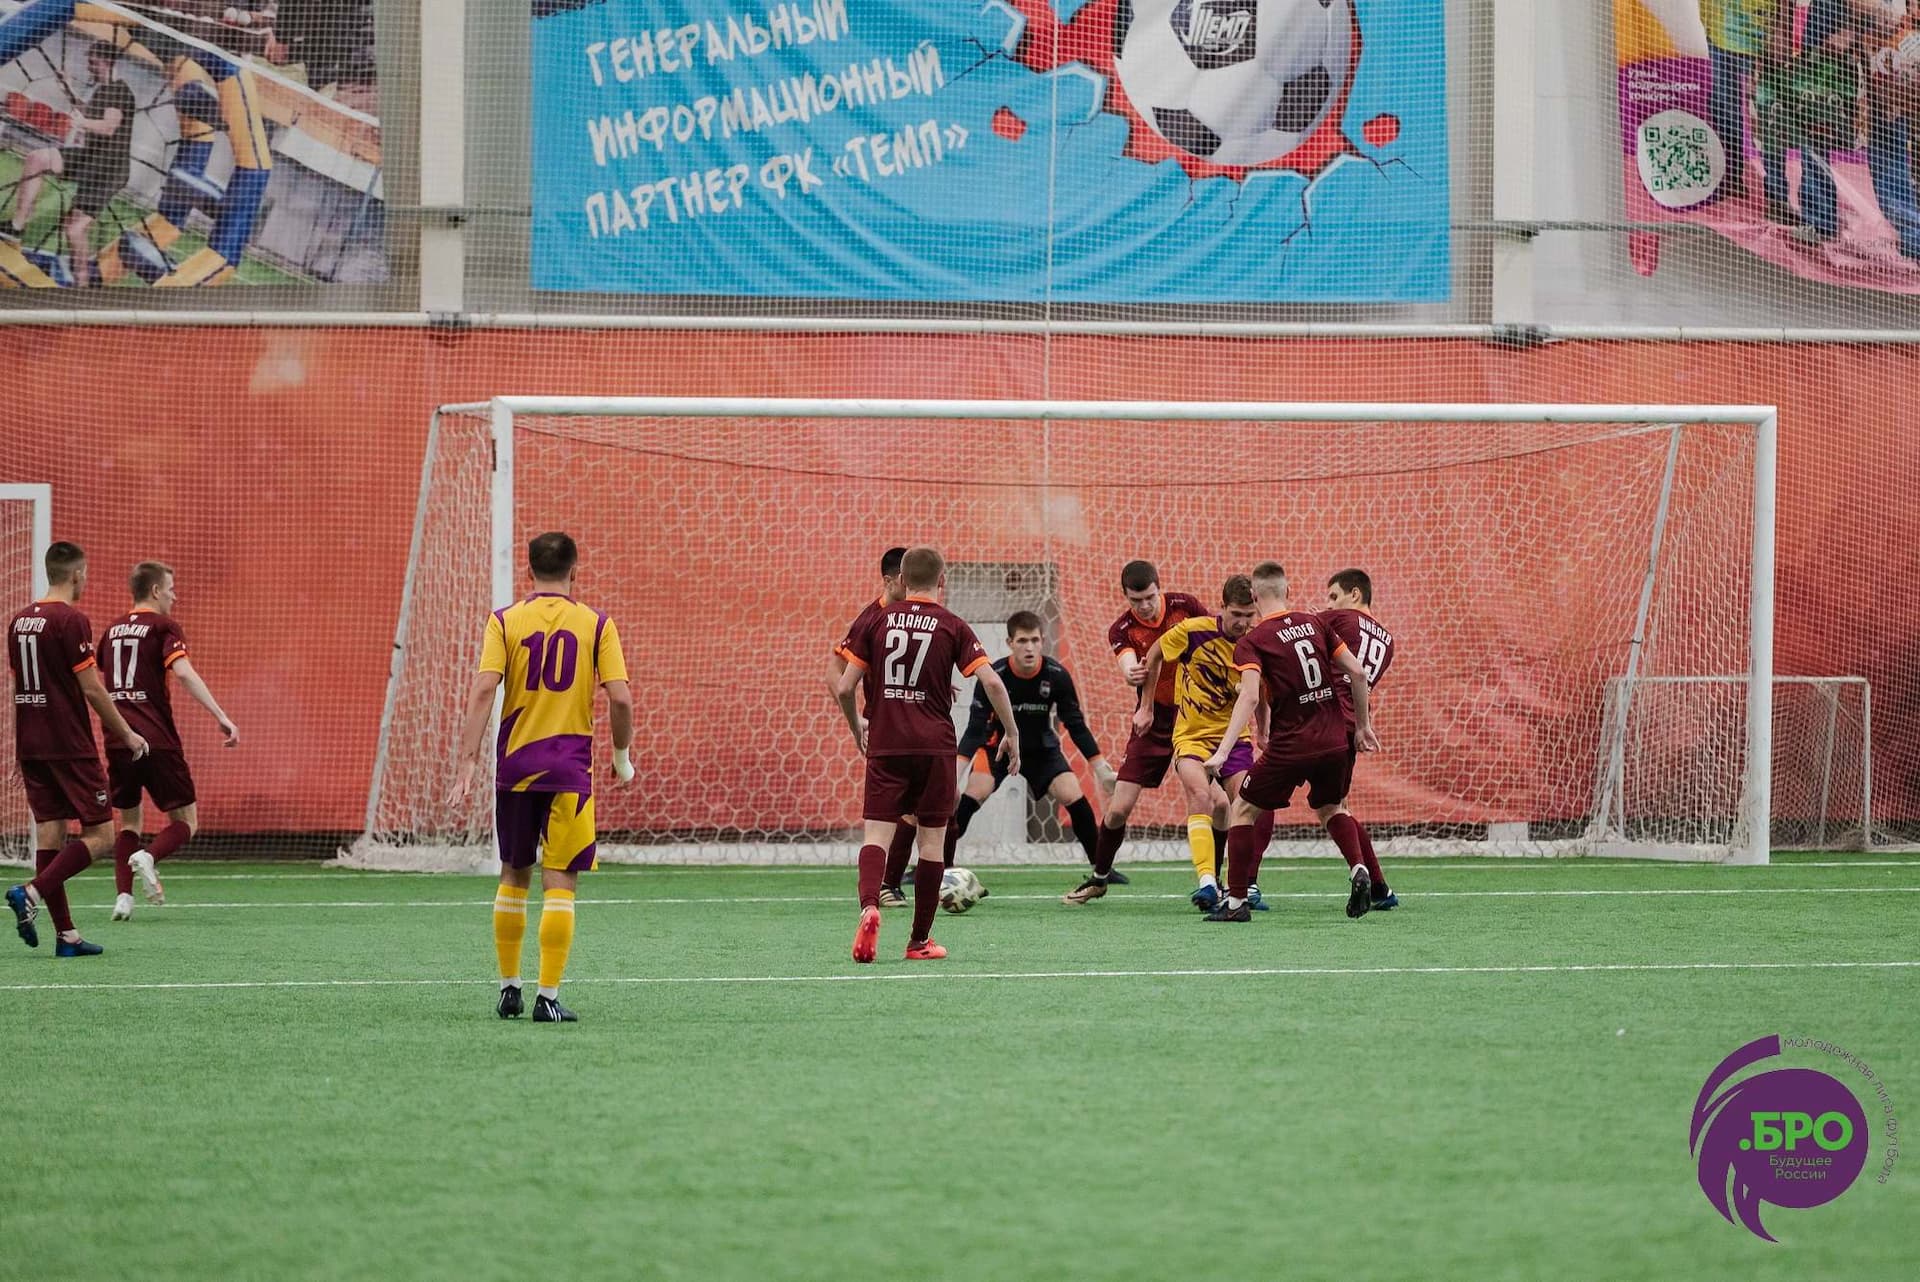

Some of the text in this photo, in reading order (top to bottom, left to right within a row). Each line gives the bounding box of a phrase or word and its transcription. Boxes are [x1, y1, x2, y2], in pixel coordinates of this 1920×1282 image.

[587, 40, 945, 167] ИНФОРМАЦИОННЫЙ
[585, 118, 970, 239] ПАРТНЕР ФК «ТЕМП»
[886, 612, 938, 631] ЖДАНОВ
[1276, 622, 1315, 643] КНЯЗЕВ
[1358, 615, 1392, 646] ШИБАЕВ
[18, 634, 40, 690] 11
[111, 638, 139, 689] 17
[520, 629, 578, 692] 10
[885, 629, 933, 687] 27
[1294, 639, 1322, 689] 6
[1356, 629, 1386, 683] 19
[15, 694, 47, 703] SEUS
[110, 691, 147, 701] SEUS
[884, 688, 926, 700] SEUS
[1299, 687, 1333, 704] SEUS
